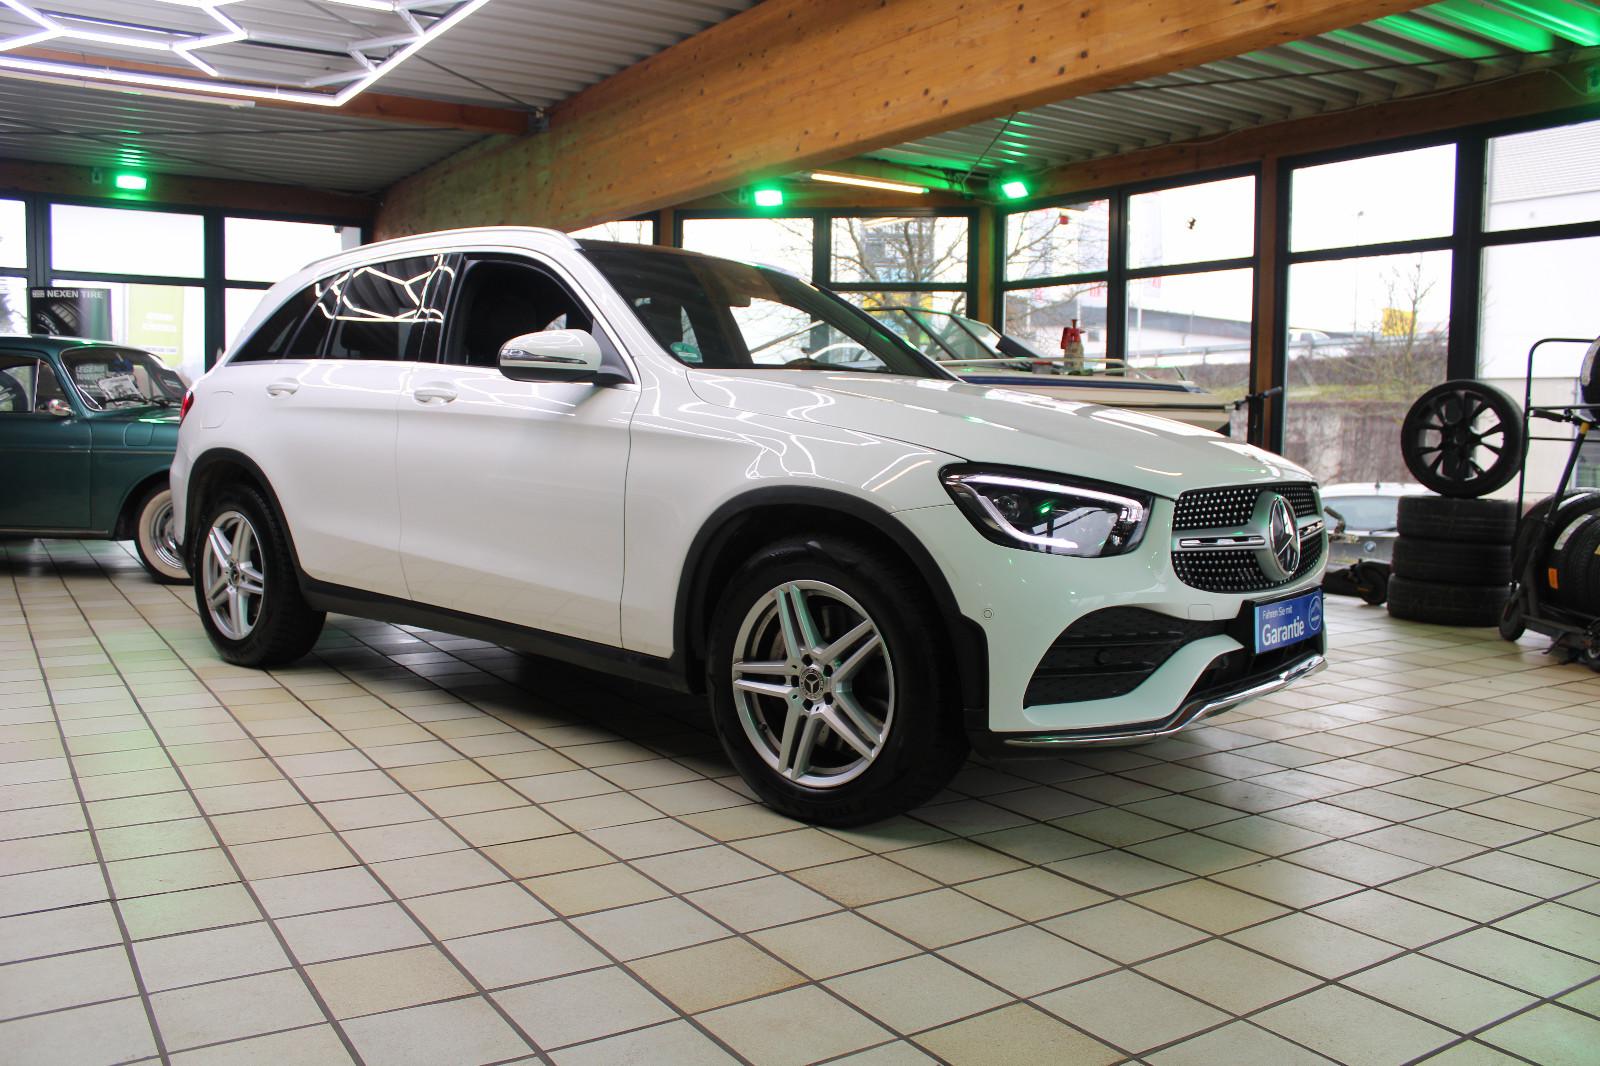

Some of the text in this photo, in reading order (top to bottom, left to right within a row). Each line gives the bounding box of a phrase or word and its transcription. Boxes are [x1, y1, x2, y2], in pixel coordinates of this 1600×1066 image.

[47, 290, 79, 298] NEXEN
[1263, 609, 1278, 619] Fahren
[1262, 616, 1304, 646] Garantie
